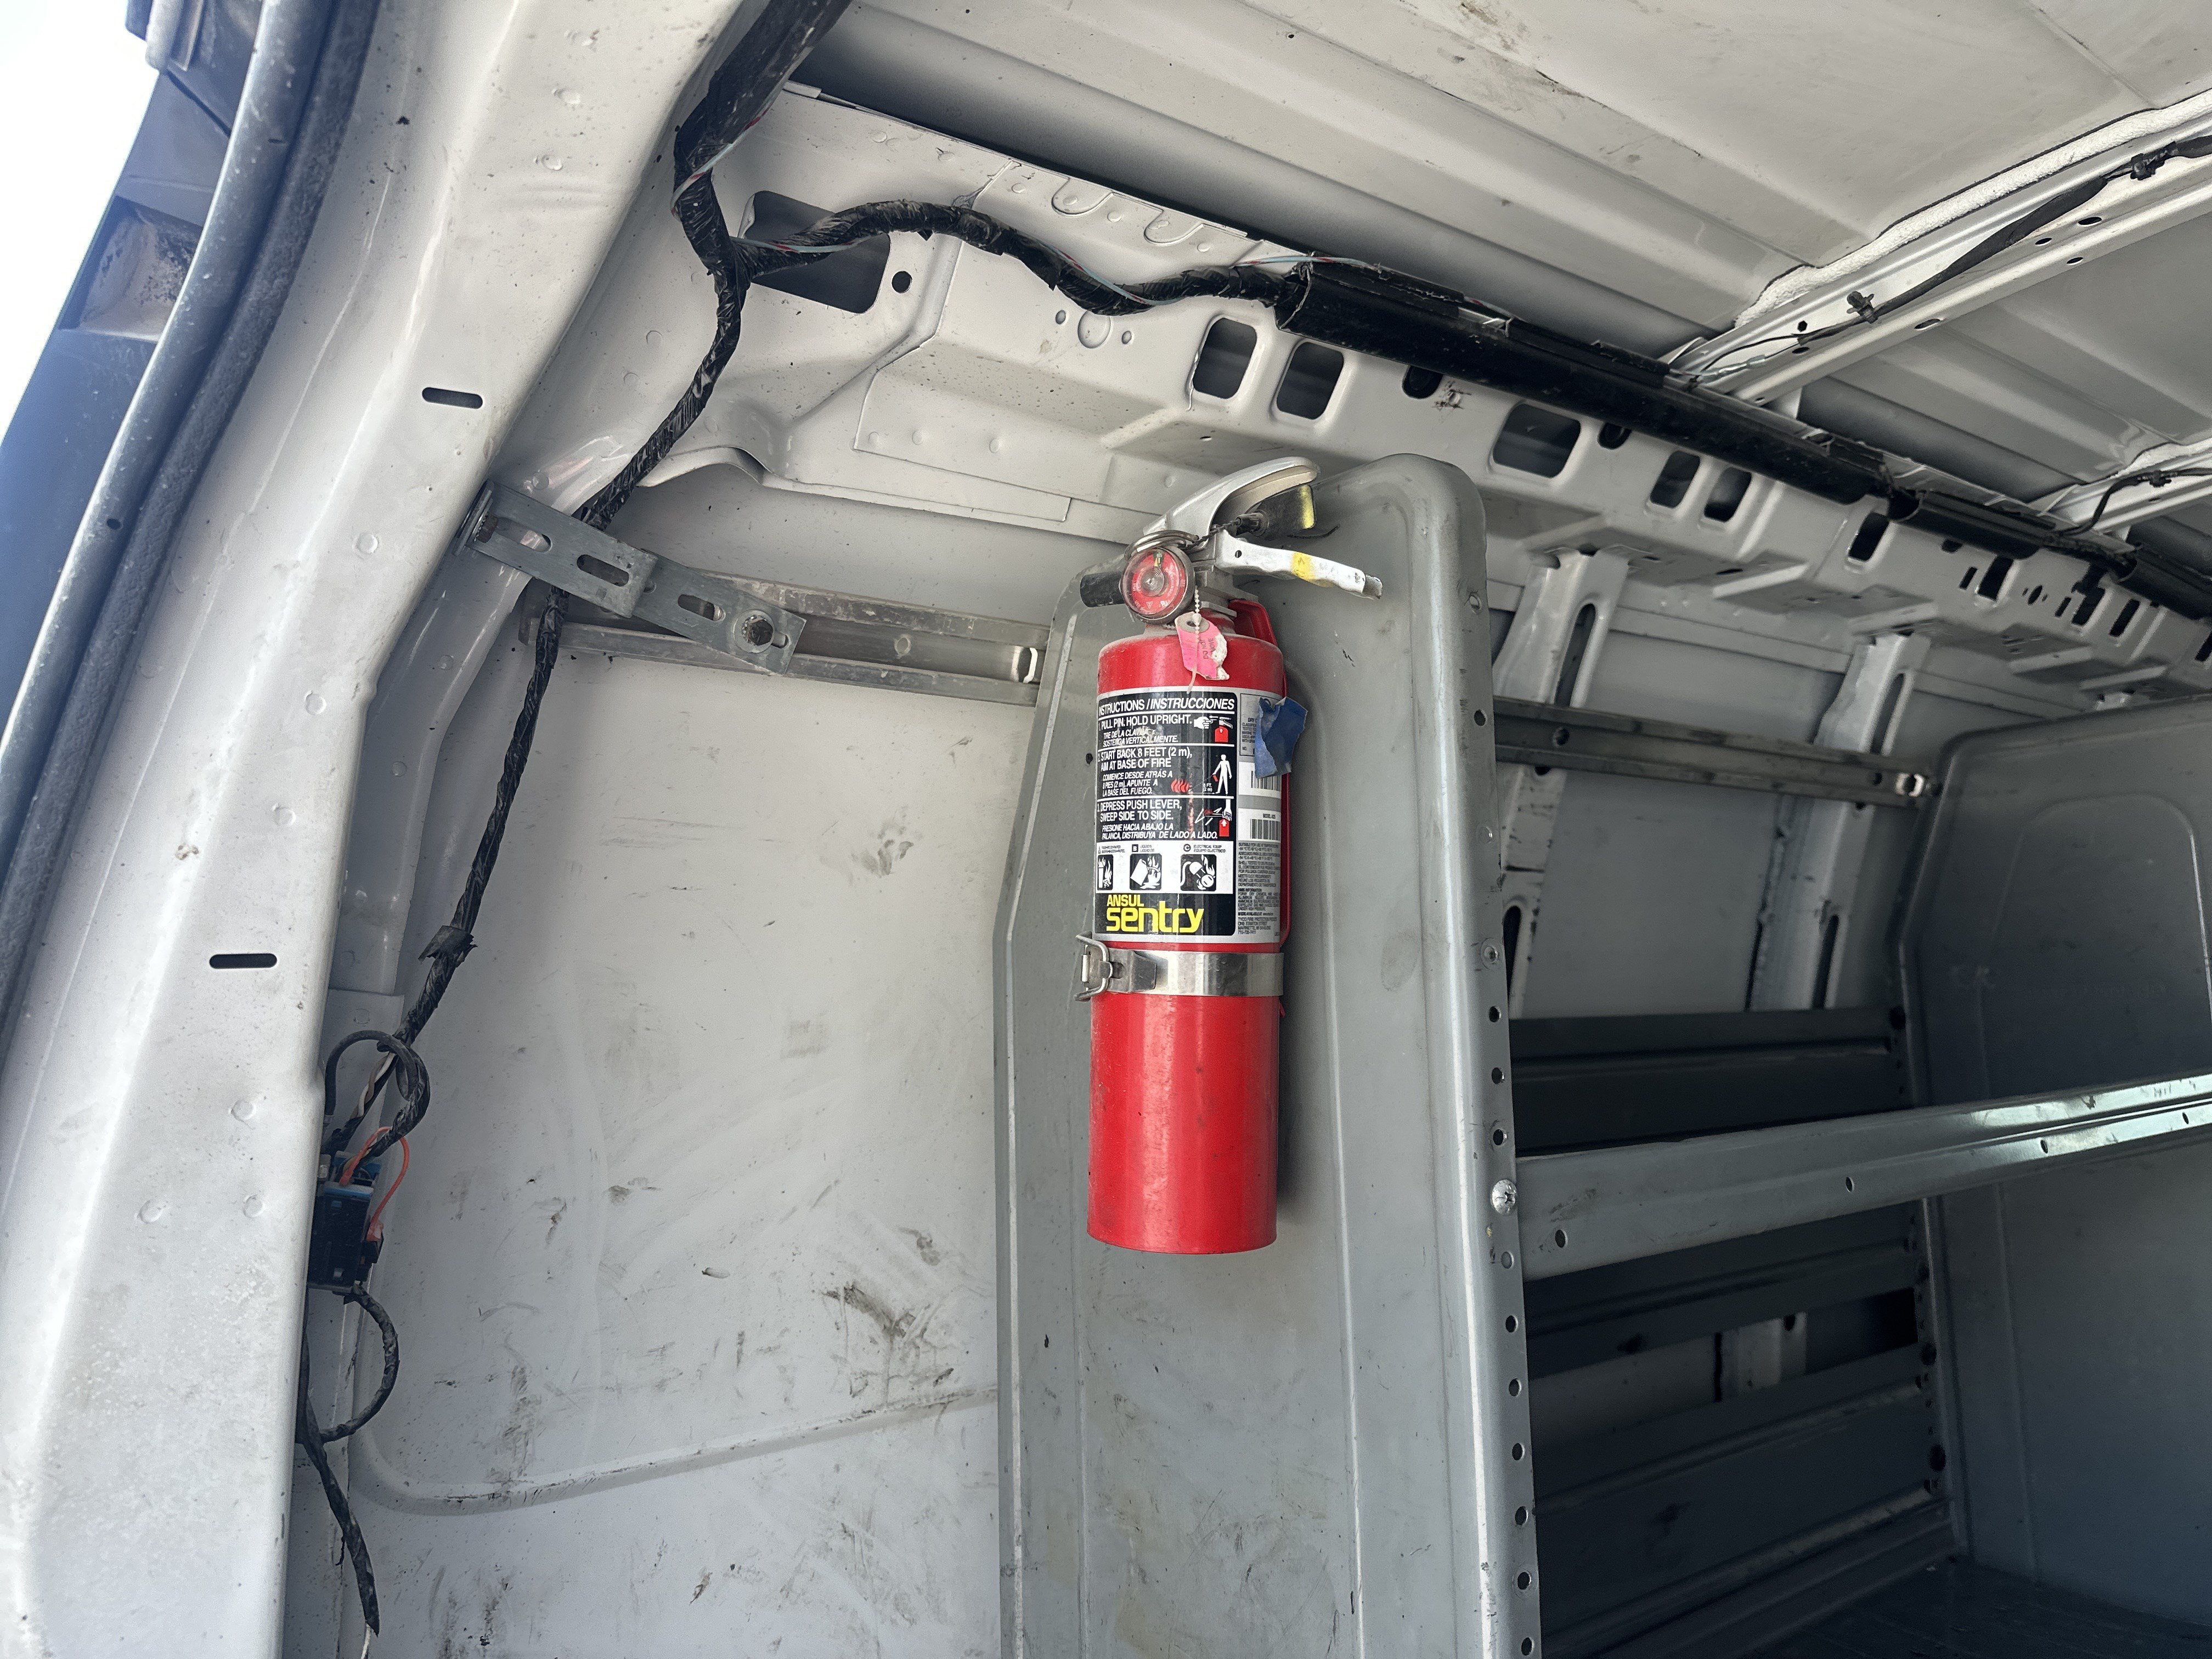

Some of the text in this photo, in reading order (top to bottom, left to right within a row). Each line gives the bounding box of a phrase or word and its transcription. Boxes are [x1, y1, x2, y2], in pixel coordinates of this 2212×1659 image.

[1101, 719, 1113, 730] PULL
[1114, 717, 1125, 728] PIN.
[1126, 715, 1148, 726] HOLD
[1150, 714, 1192, 725] UPRIGHT.
[1126, 735, 1178, 744] VERTICALMENTE.
[1101, 750, 1116, 761] START
[1116, 748, 1137, 759] BACK
[1137, 748, 1143, 758] 8
[1144, 747, 1167, 757] FEET
[1168, 746, 1177, 759] (2
[1178, 746, 1193, 759] m),
[1101, 758, 1171, 772] AIM AT BASE OF FIRE
[1103, 772, 1124, 781] COMIENCE
[1125, 771, 1144, 780] DESDE
[1144, 769, 1167, 778] ATRÁS
[1126, 778, 1151, 787] APUNTE
[1130, 787, 1153, 795] FUEGO.
[1101, 800, 1125, 812] DEPRESS
[1126, 799, 1148, 810] PUSH
[1149, 799, 1182, 810] LEVER,
[1100, 810, 1173, 822] SWEEP SIDE TO SIDE.
[1102, 822, 1173, 832] PRESIONE HACIA ABAJO LA
[1102, 832, 1121, 840] PALANCA,
[1122, 831, 1156, 839] DISTRIBUYA
[1159, 831, 1169, 839] DE
[1170, 831, 1189, 839] LADO
[1107, 894, 1144, 907] ANSUL
[1106, 900, 1205, 933] sentry
